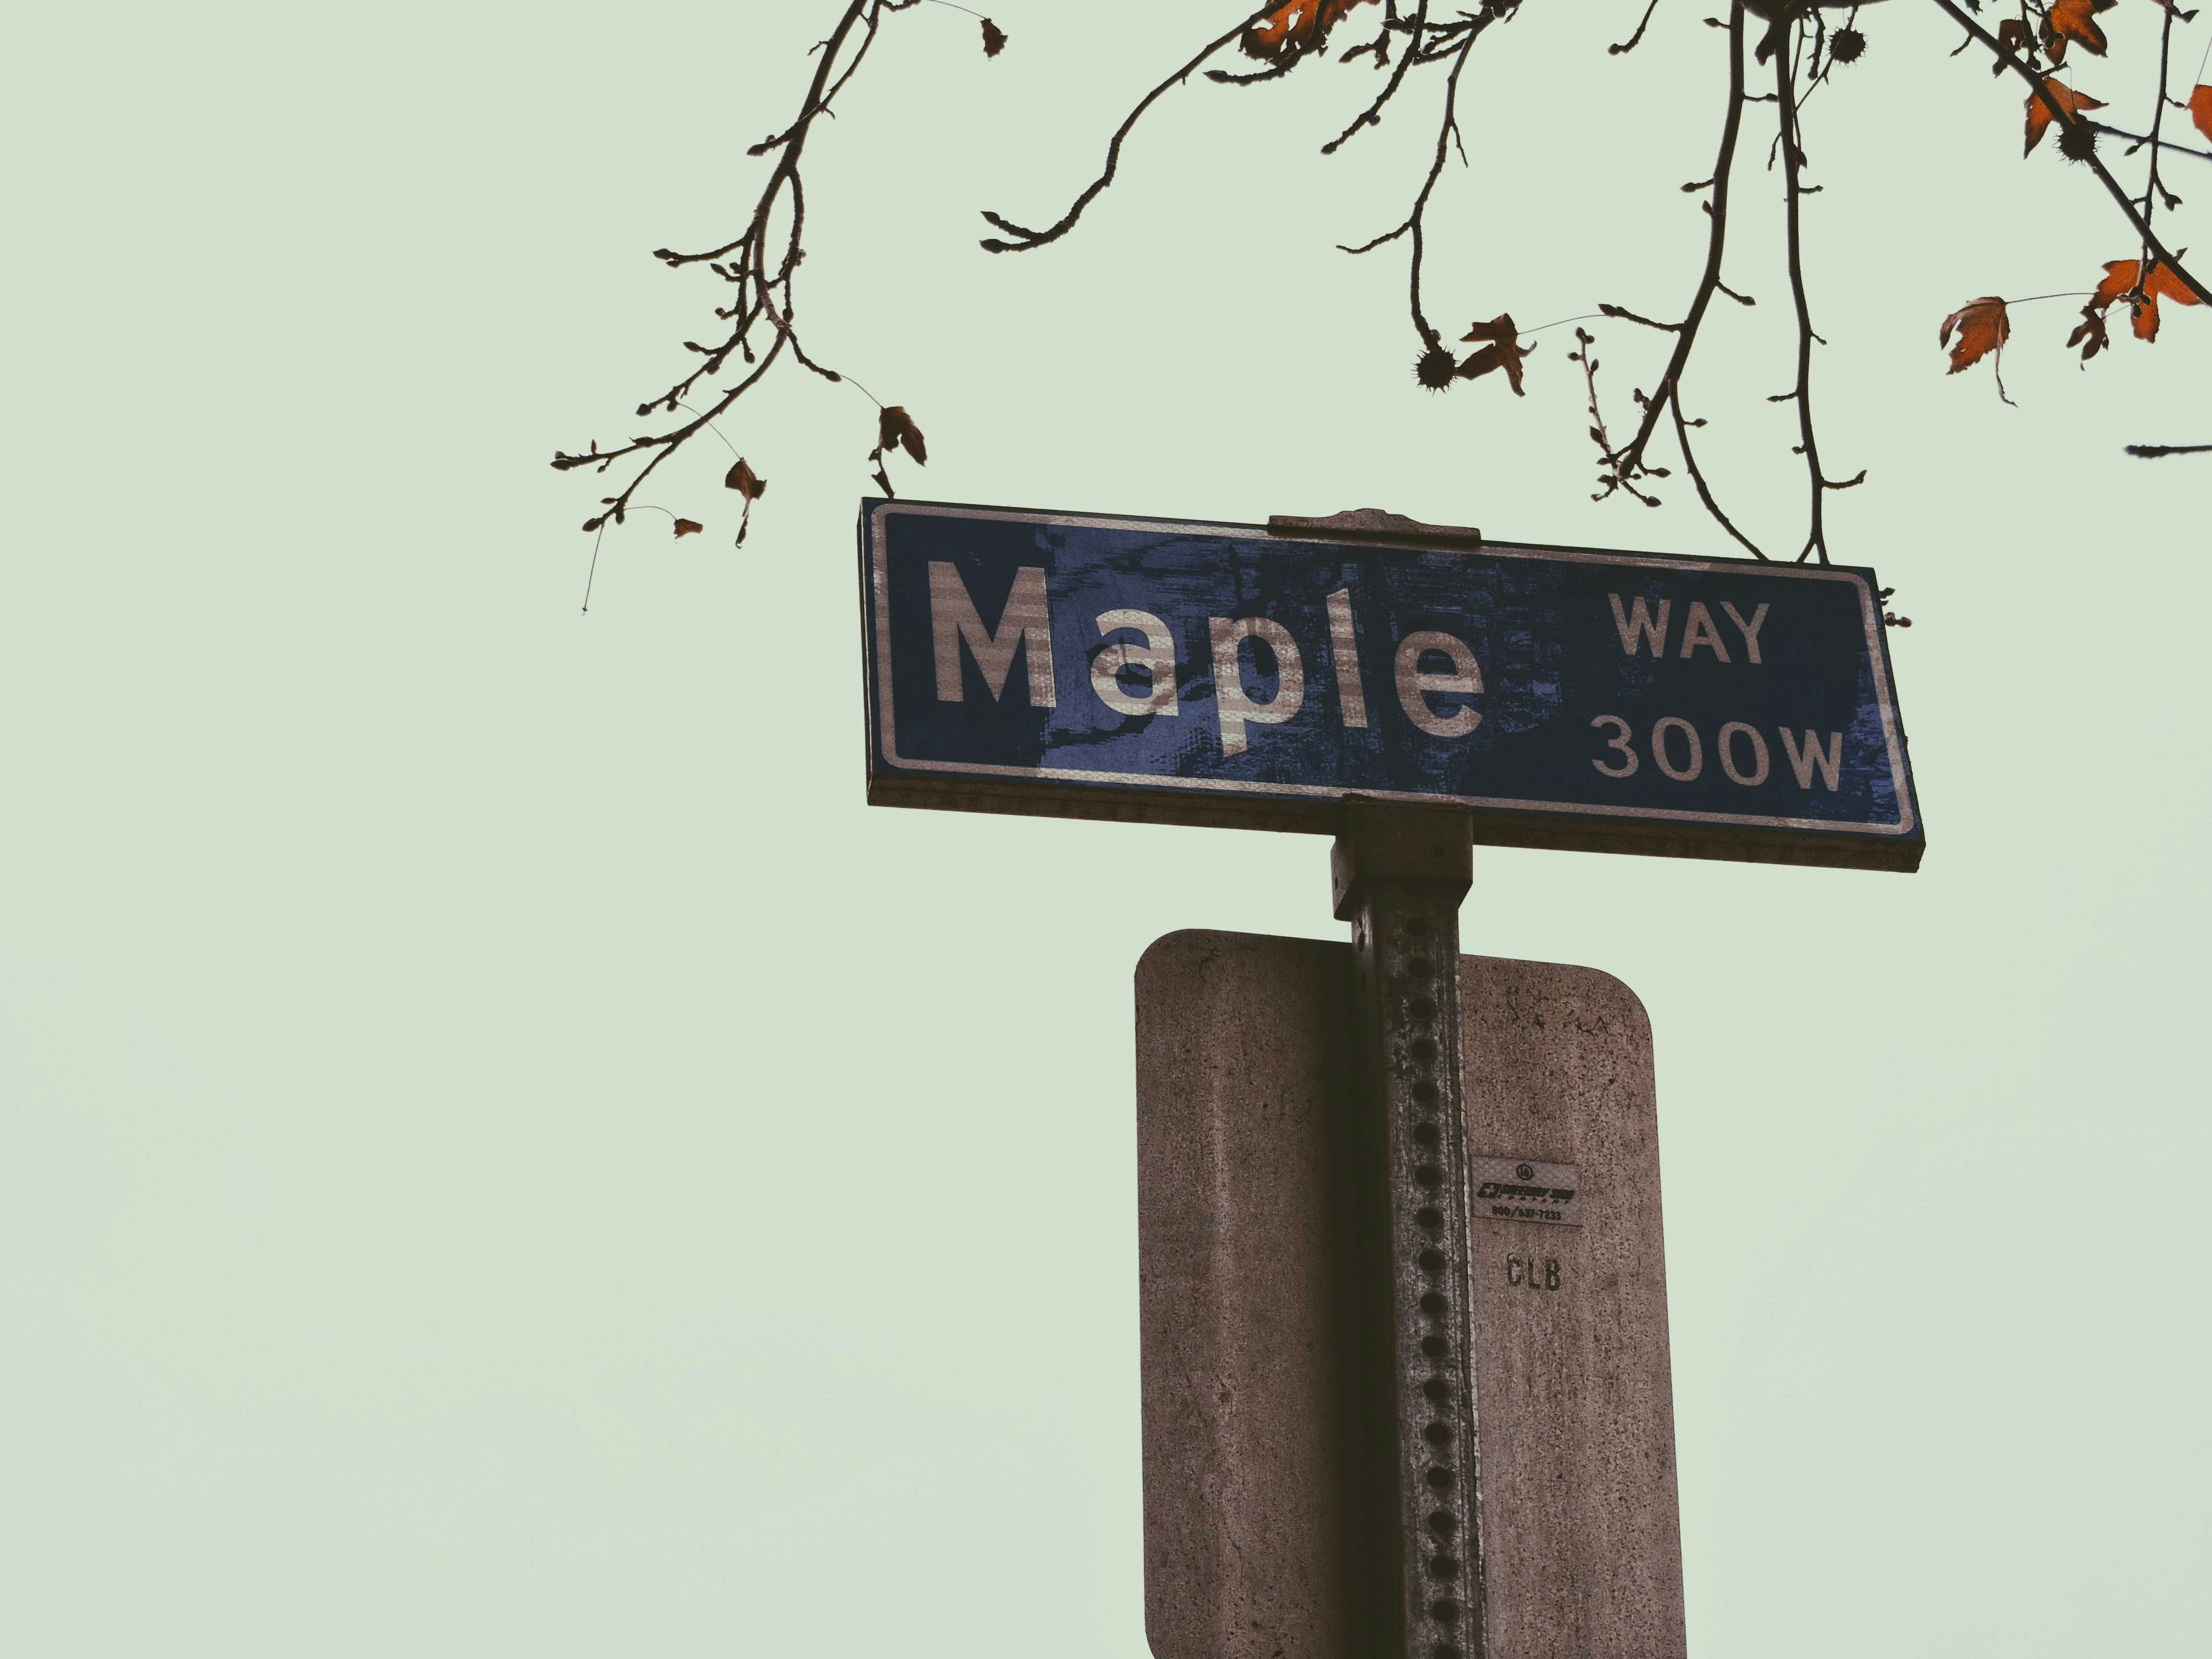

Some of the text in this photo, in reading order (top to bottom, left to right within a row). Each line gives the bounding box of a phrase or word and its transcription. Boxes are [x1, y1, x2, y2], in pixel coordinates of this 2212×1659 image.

[927, 560, 1484, 757] Maple
[1608, 592, 1770, 664] WAY
[1590, 714, 1843, 792] 300W
[1491, 1205, 1562, 1220] 800/637-7233
[1506, 1256, 1560, 1291] CLB
